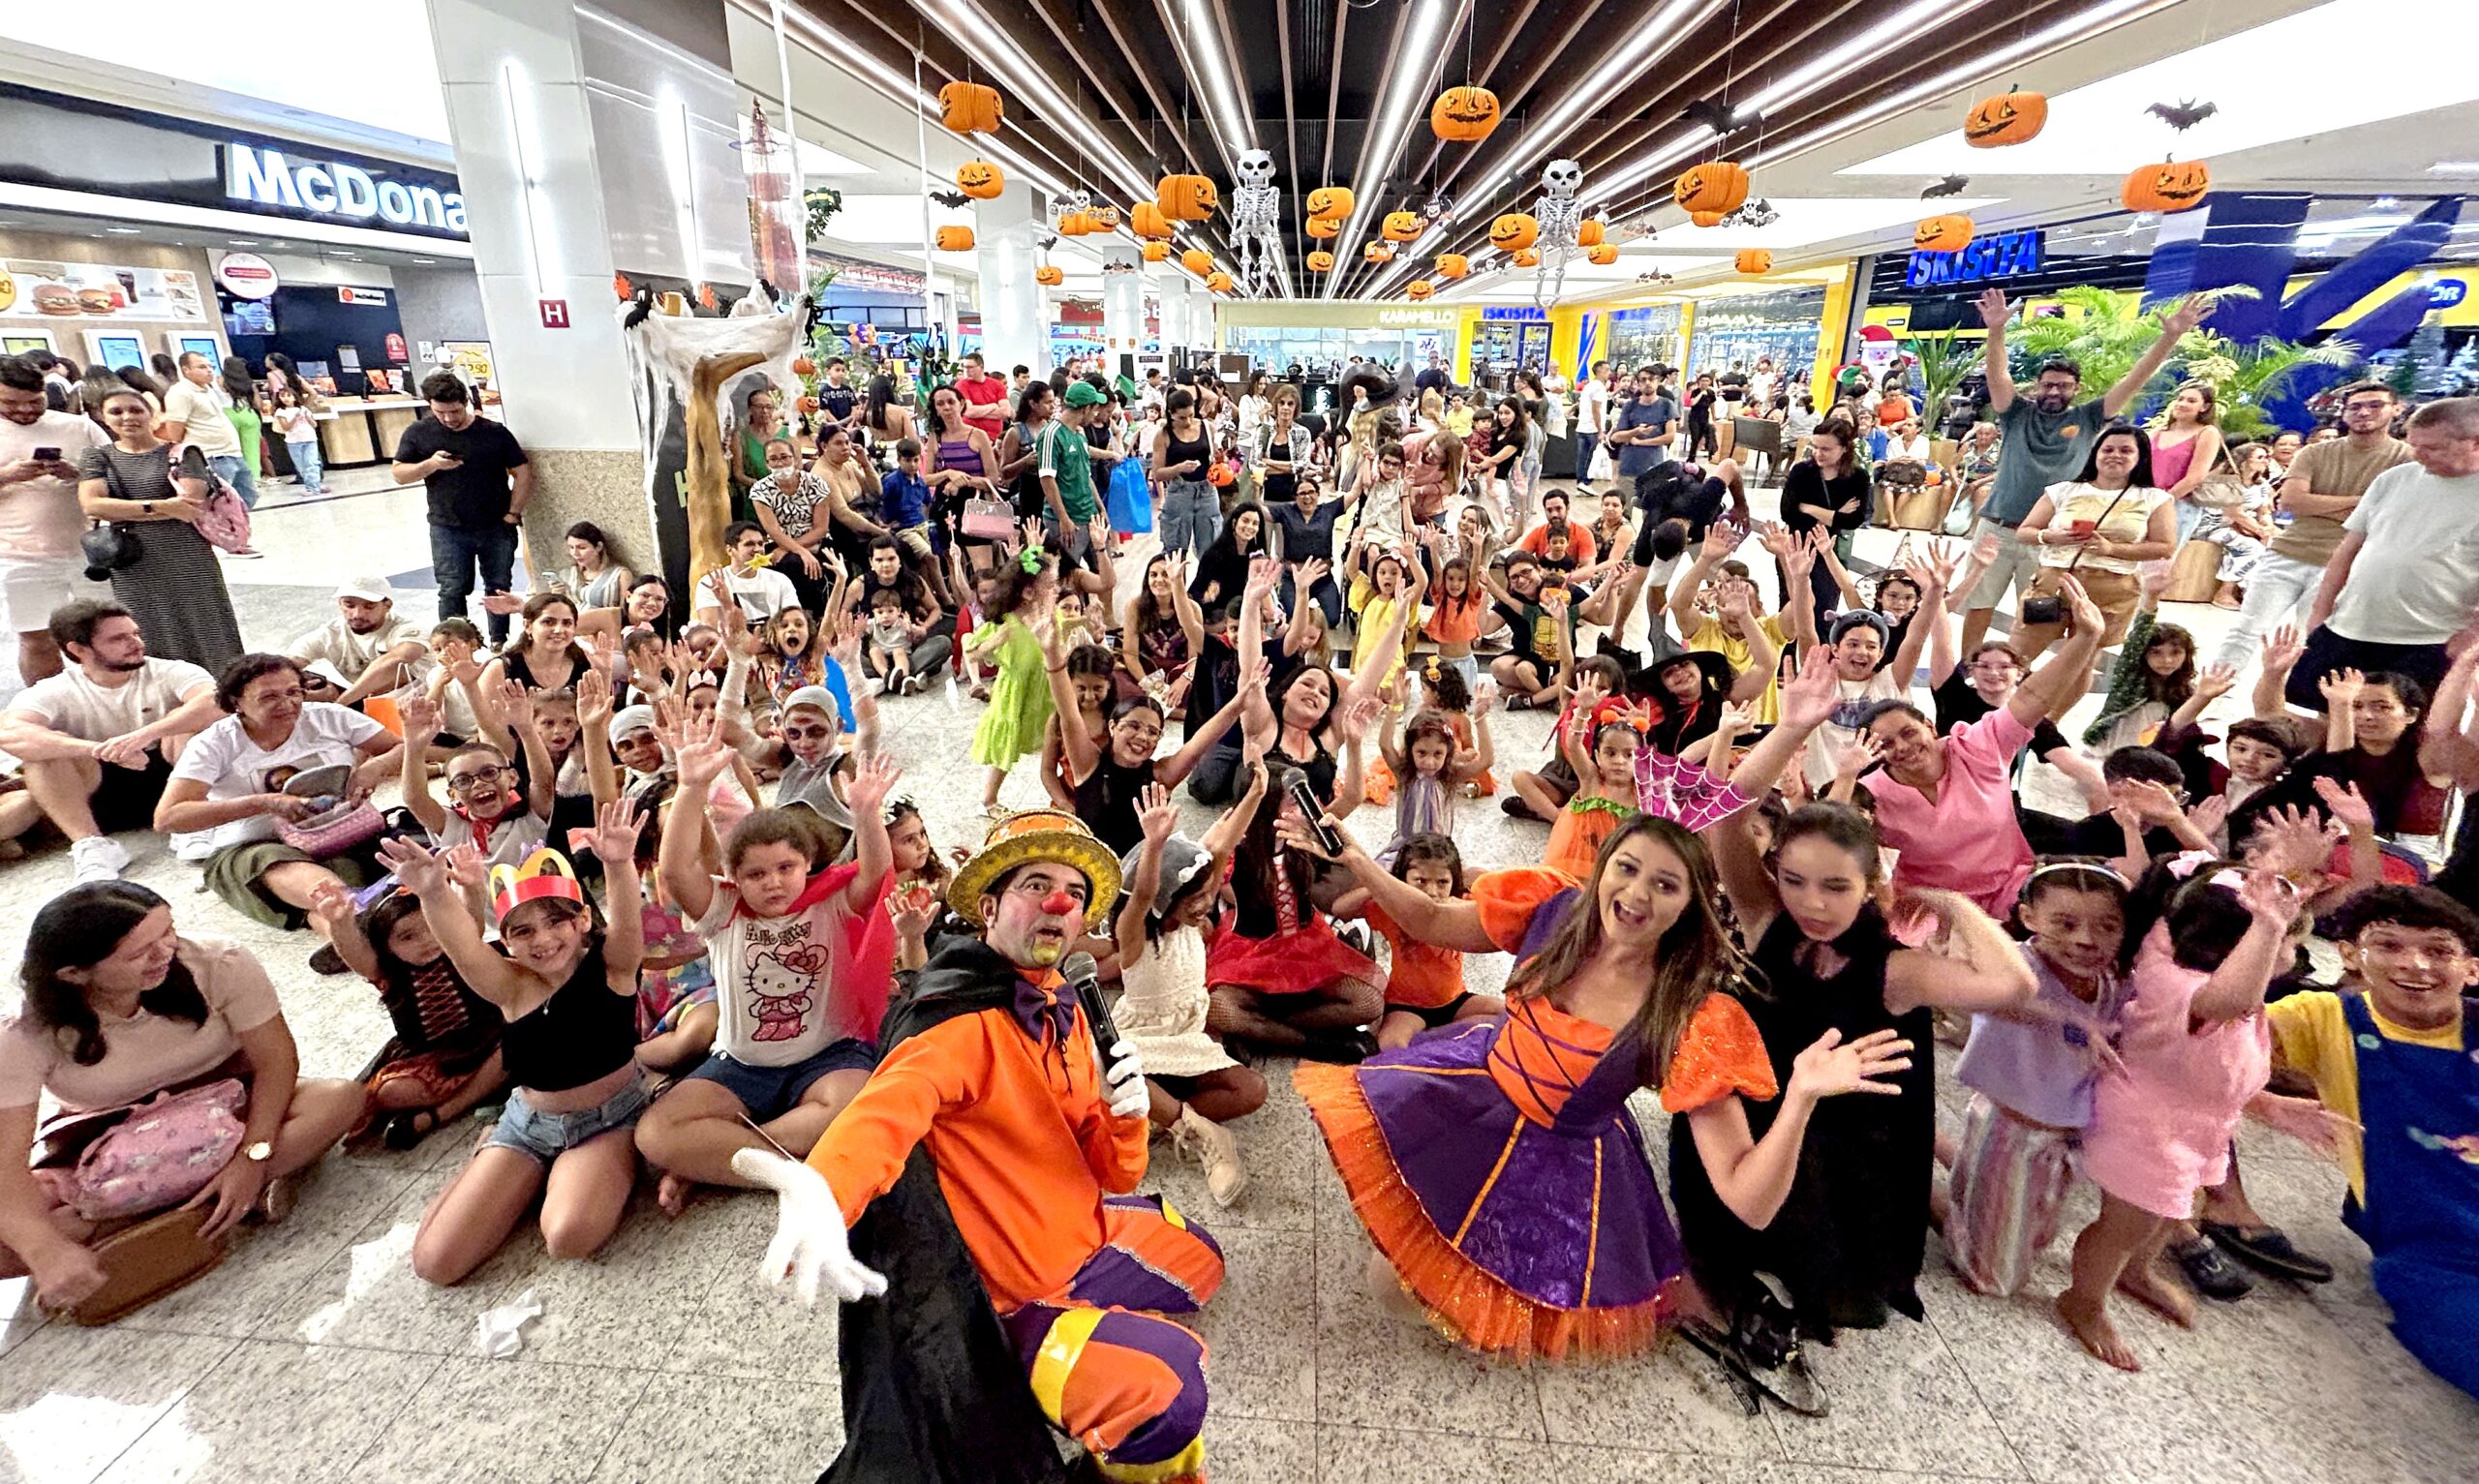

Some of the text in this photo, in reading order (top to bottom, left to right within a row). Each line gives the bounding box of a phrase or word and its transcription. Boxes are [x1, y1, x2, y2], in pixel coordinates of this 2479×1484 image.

[1906, 230, 2037, 287] ISKISITA
[543, 304, 564, 322] H
[1379, 310, 1455, 323] KARAMELLO
